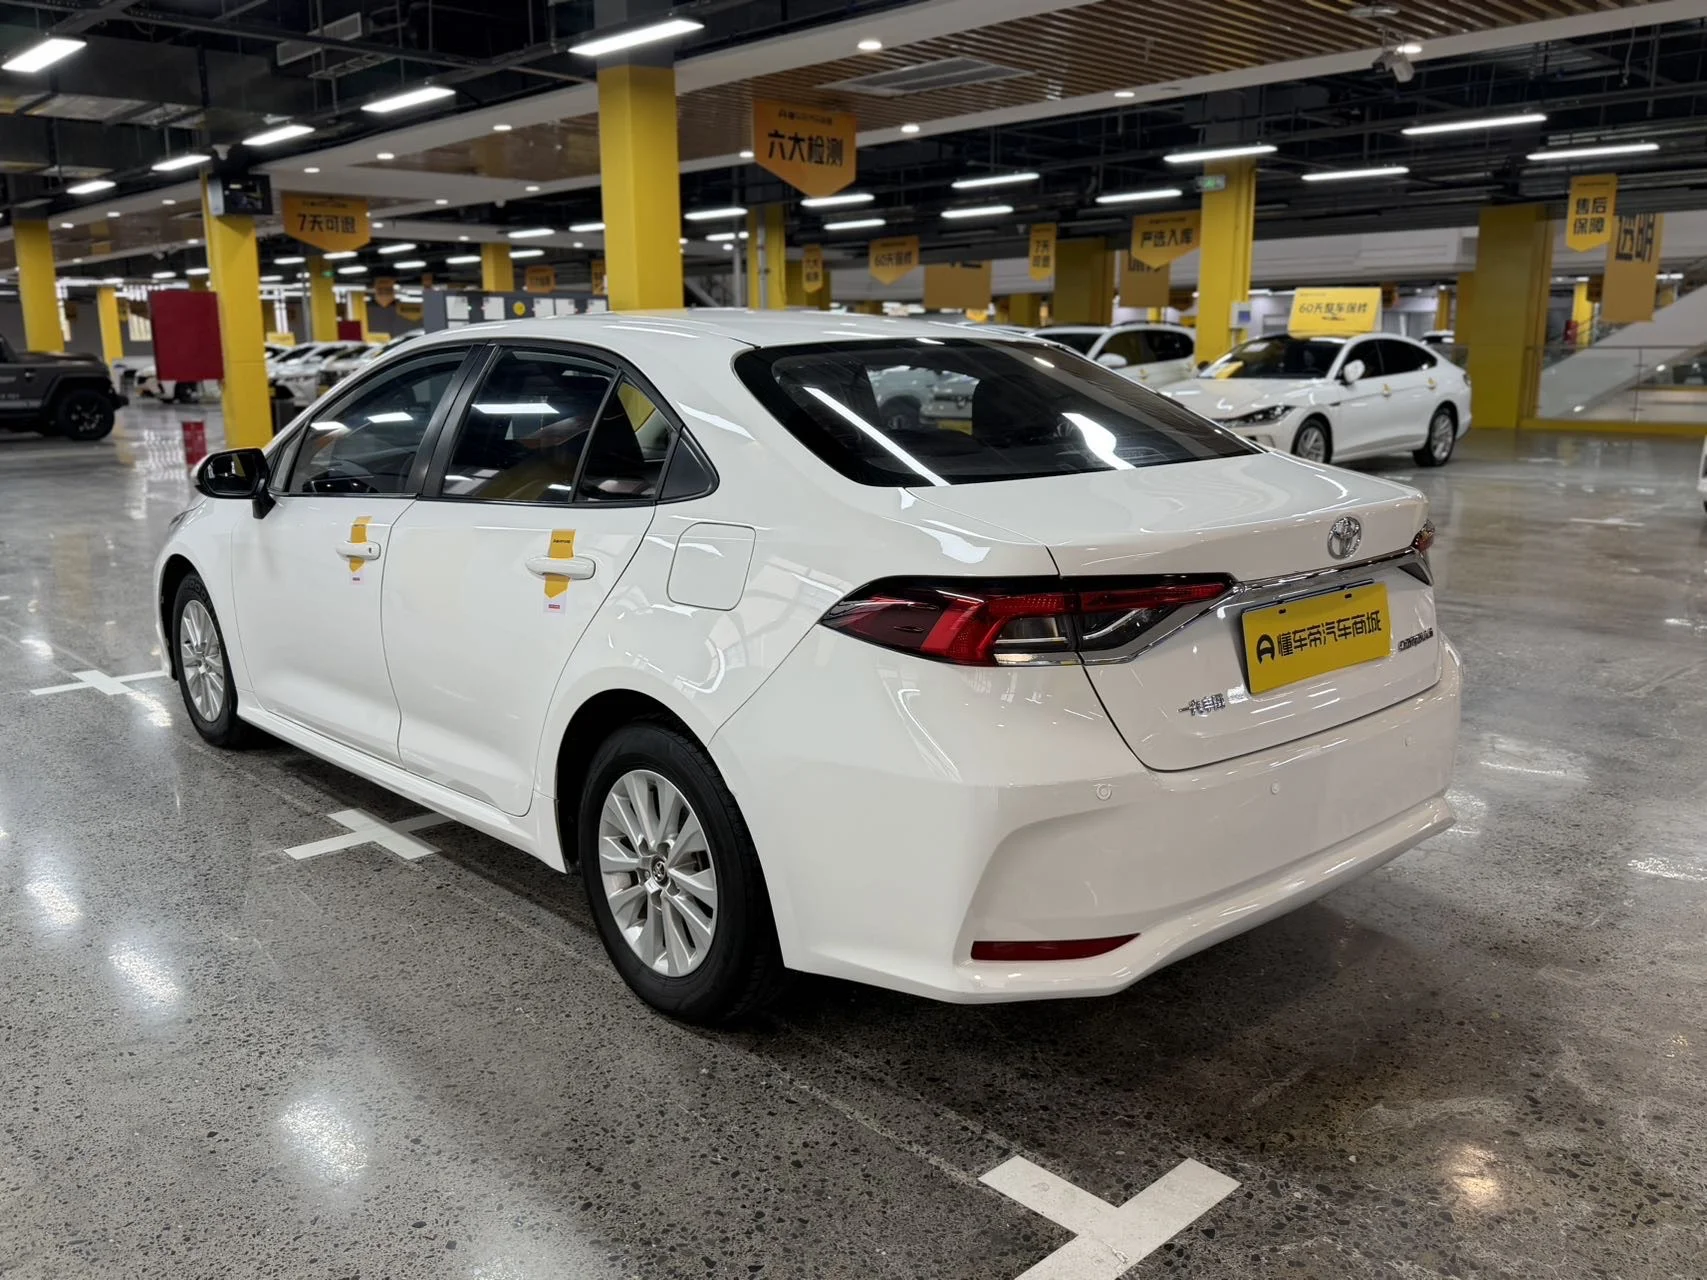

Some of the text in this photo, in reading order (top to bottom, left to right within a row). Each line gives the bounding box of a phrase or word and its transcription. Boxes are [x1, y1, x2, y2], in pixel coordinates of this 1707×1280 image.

[768, 129, 843, 167] 六大检测
[1576, 196, 1608, 215] 售后
[297, 213, 356, 233] 7天可退
[1574, 217, 1605, 235] 保障
[1141, 228, 1193, 248] 严选入库
